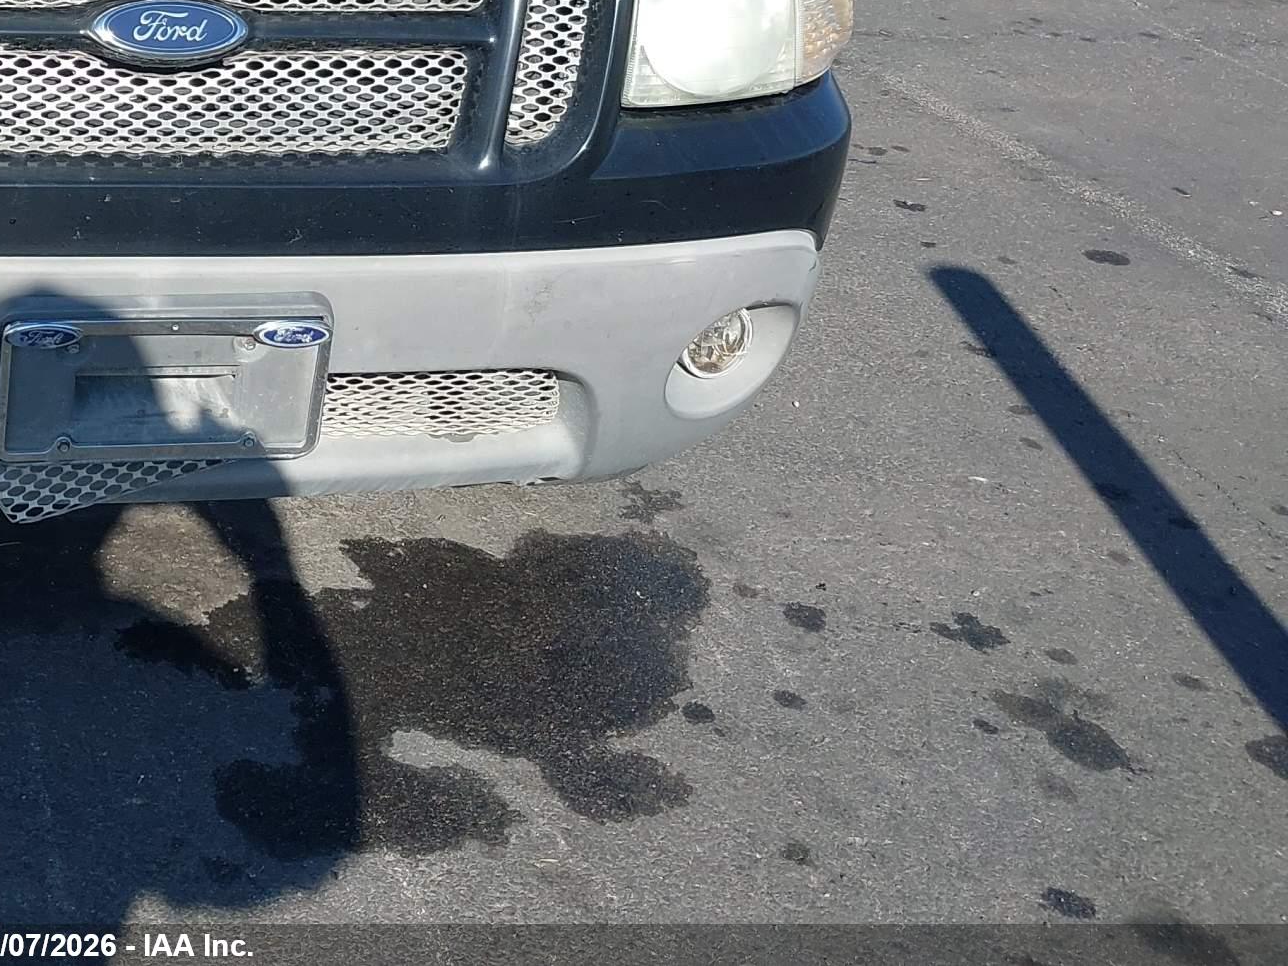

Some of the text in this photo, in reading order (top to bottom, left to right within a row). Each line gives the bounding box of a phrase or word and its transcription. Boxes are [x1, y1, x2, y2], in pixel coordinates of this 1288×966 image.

[132, 10, 208, 42] Ford
[23, 330, 65, 345] Ford
[273, 326, 314, 343] Ford
